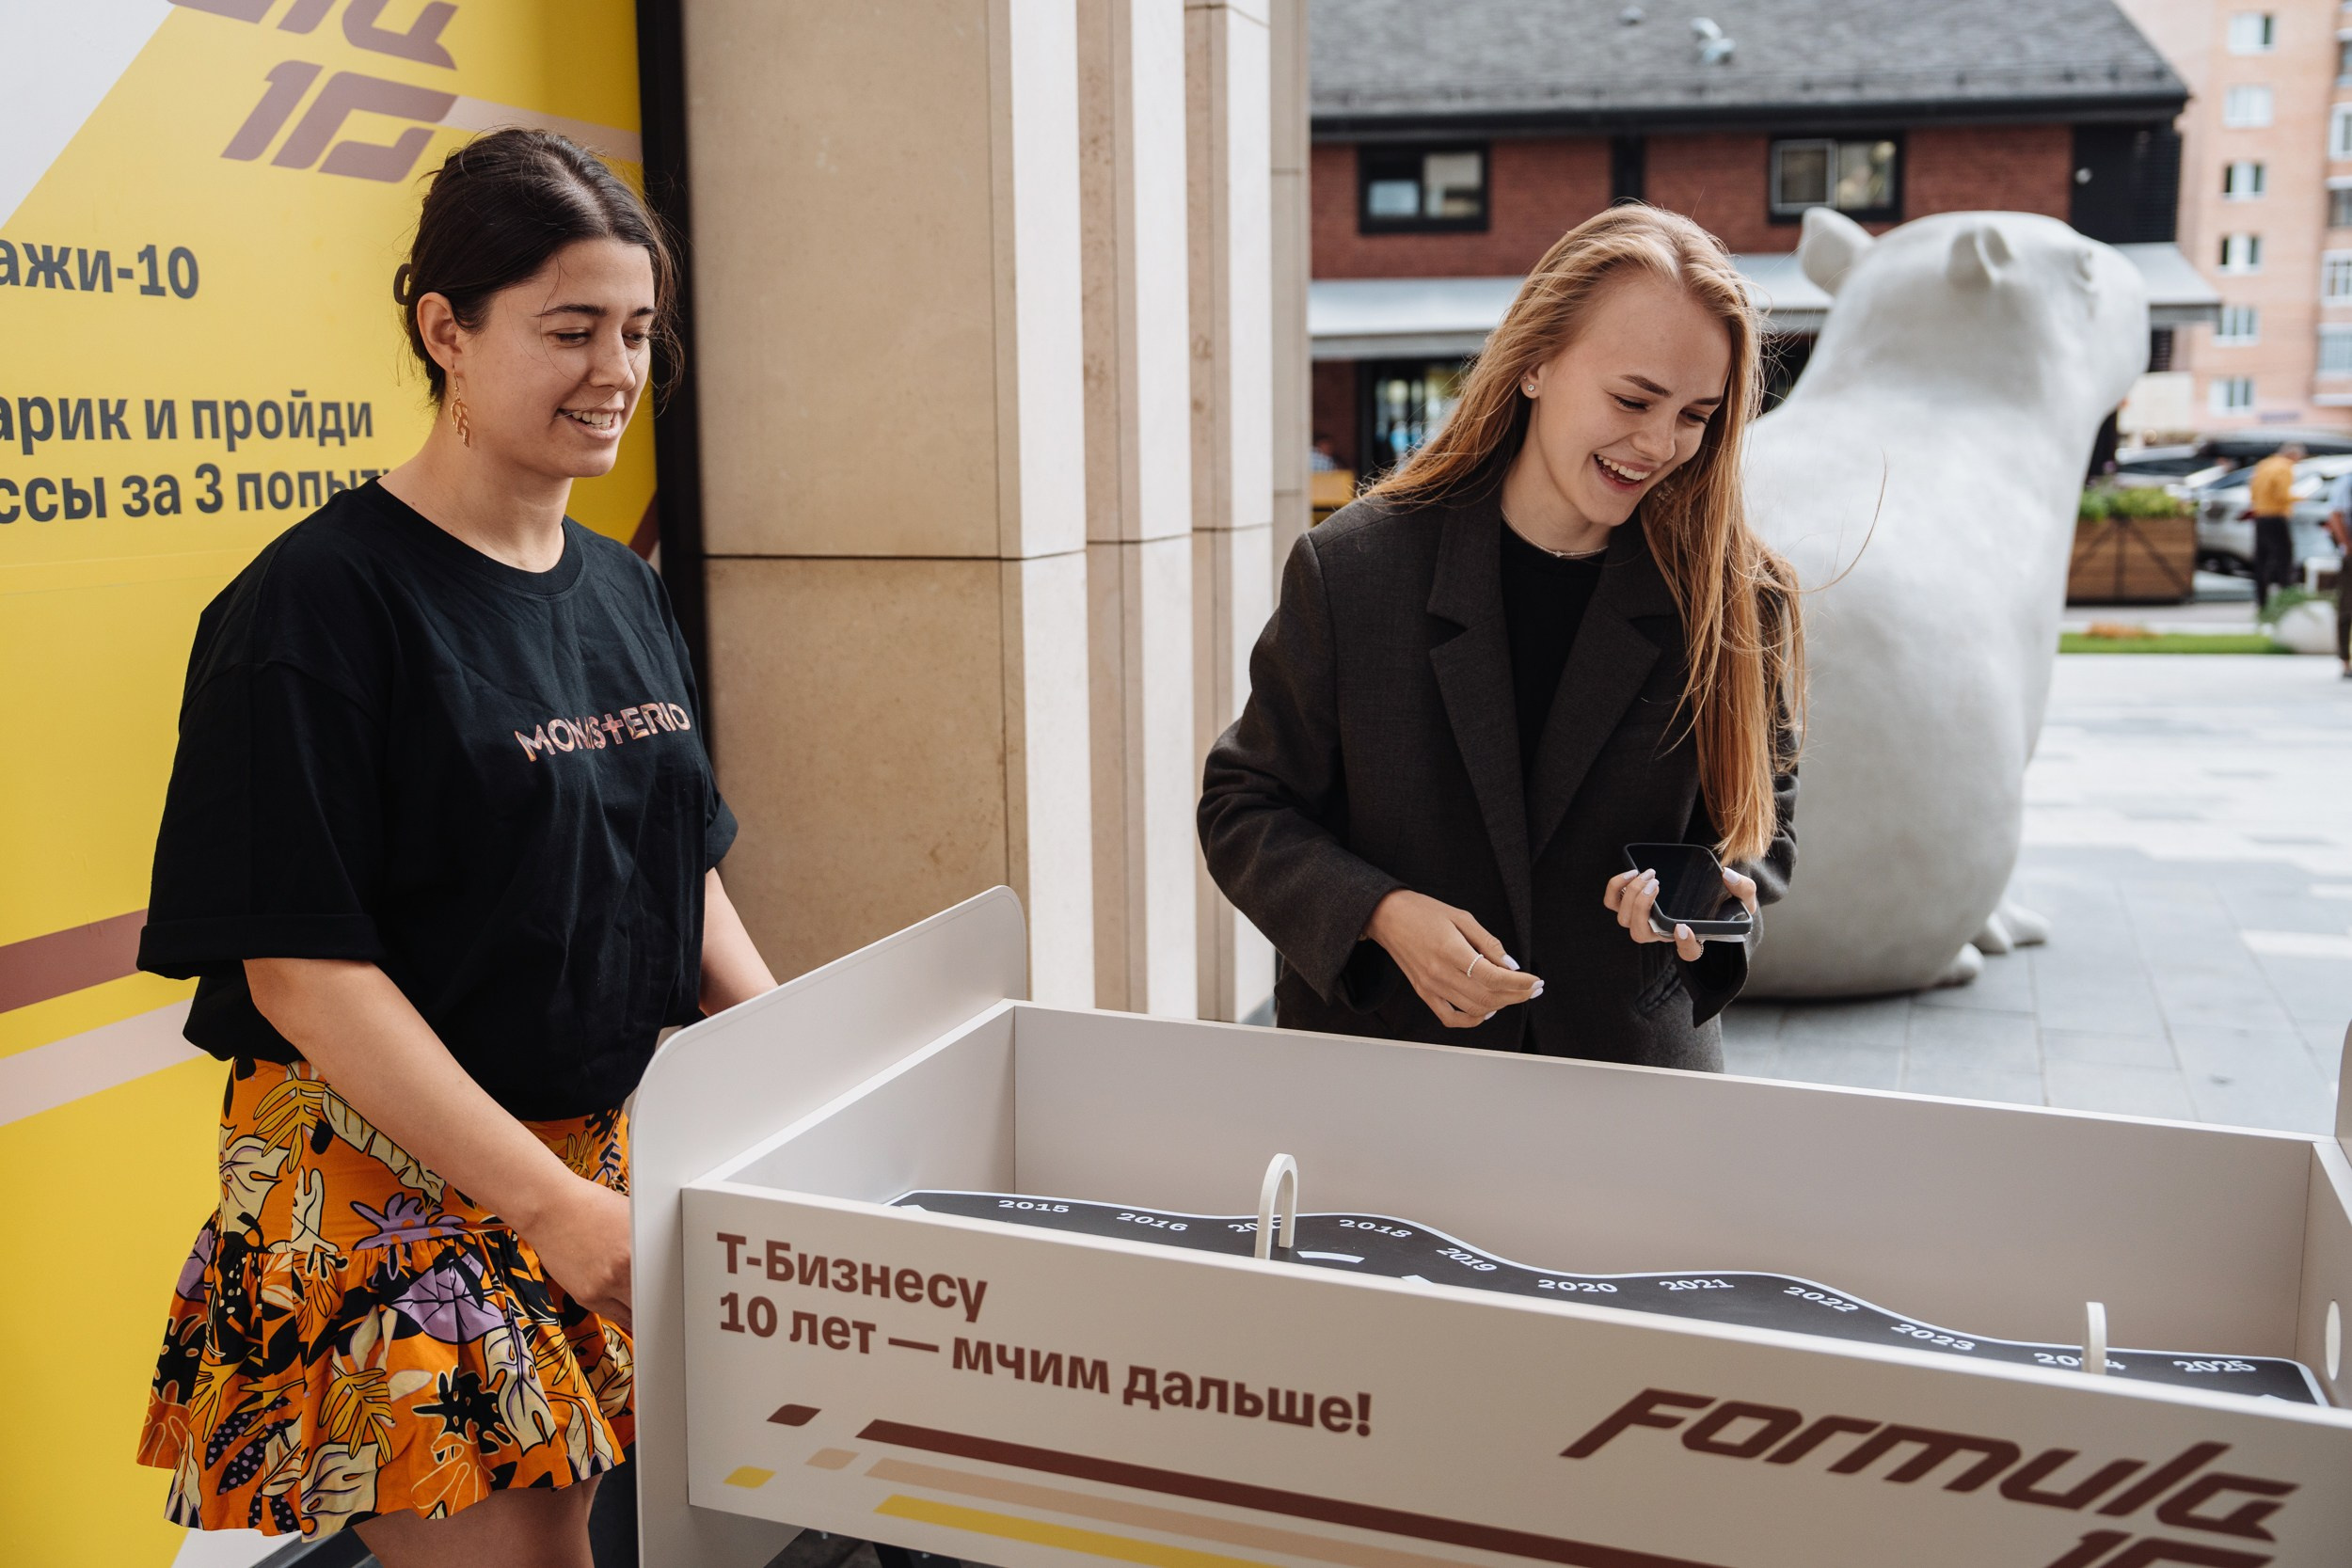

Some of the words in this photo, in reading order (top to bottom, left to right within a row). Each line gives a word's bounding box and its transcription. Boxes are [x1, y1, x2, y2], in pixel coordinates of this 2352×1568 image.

[220, 59, 459, 183] 10
[145, 399, 177, 440] и
[192, 389, 373, 452] пройди
[121, 474, 182, 517] за
[195, 463, 223, 514] 3
[717, 1232, 987, 1323] Т-Бизнесу
[998, 1199, 1070, 1213] 2015
[1117, 1212, 1188, 1231] 2016
[1339, 1219, 1412, 1239] 2018
[1436, 1247, 1498, 1273] 2019
[1538, 1278, 1618, 1293] 2020
[1659, 1278, 1734, 1291] 2021
[1784, 1286, 1859, 1313] 2022
[1891, 1323, 1976, 1352] 2023
[2034, 1353, 2126, 1370] 204
[2173, 1360, 2257, 1373] 2025
[720, 1292, 777, 1338] 10
[789, 1309, 876, 1354] лет
[952, 1336, 1110, 1394] мчим
[1123, 1363, 1373, 1438] дальше!
[1558, 1387, 2301, 1544] Formula
